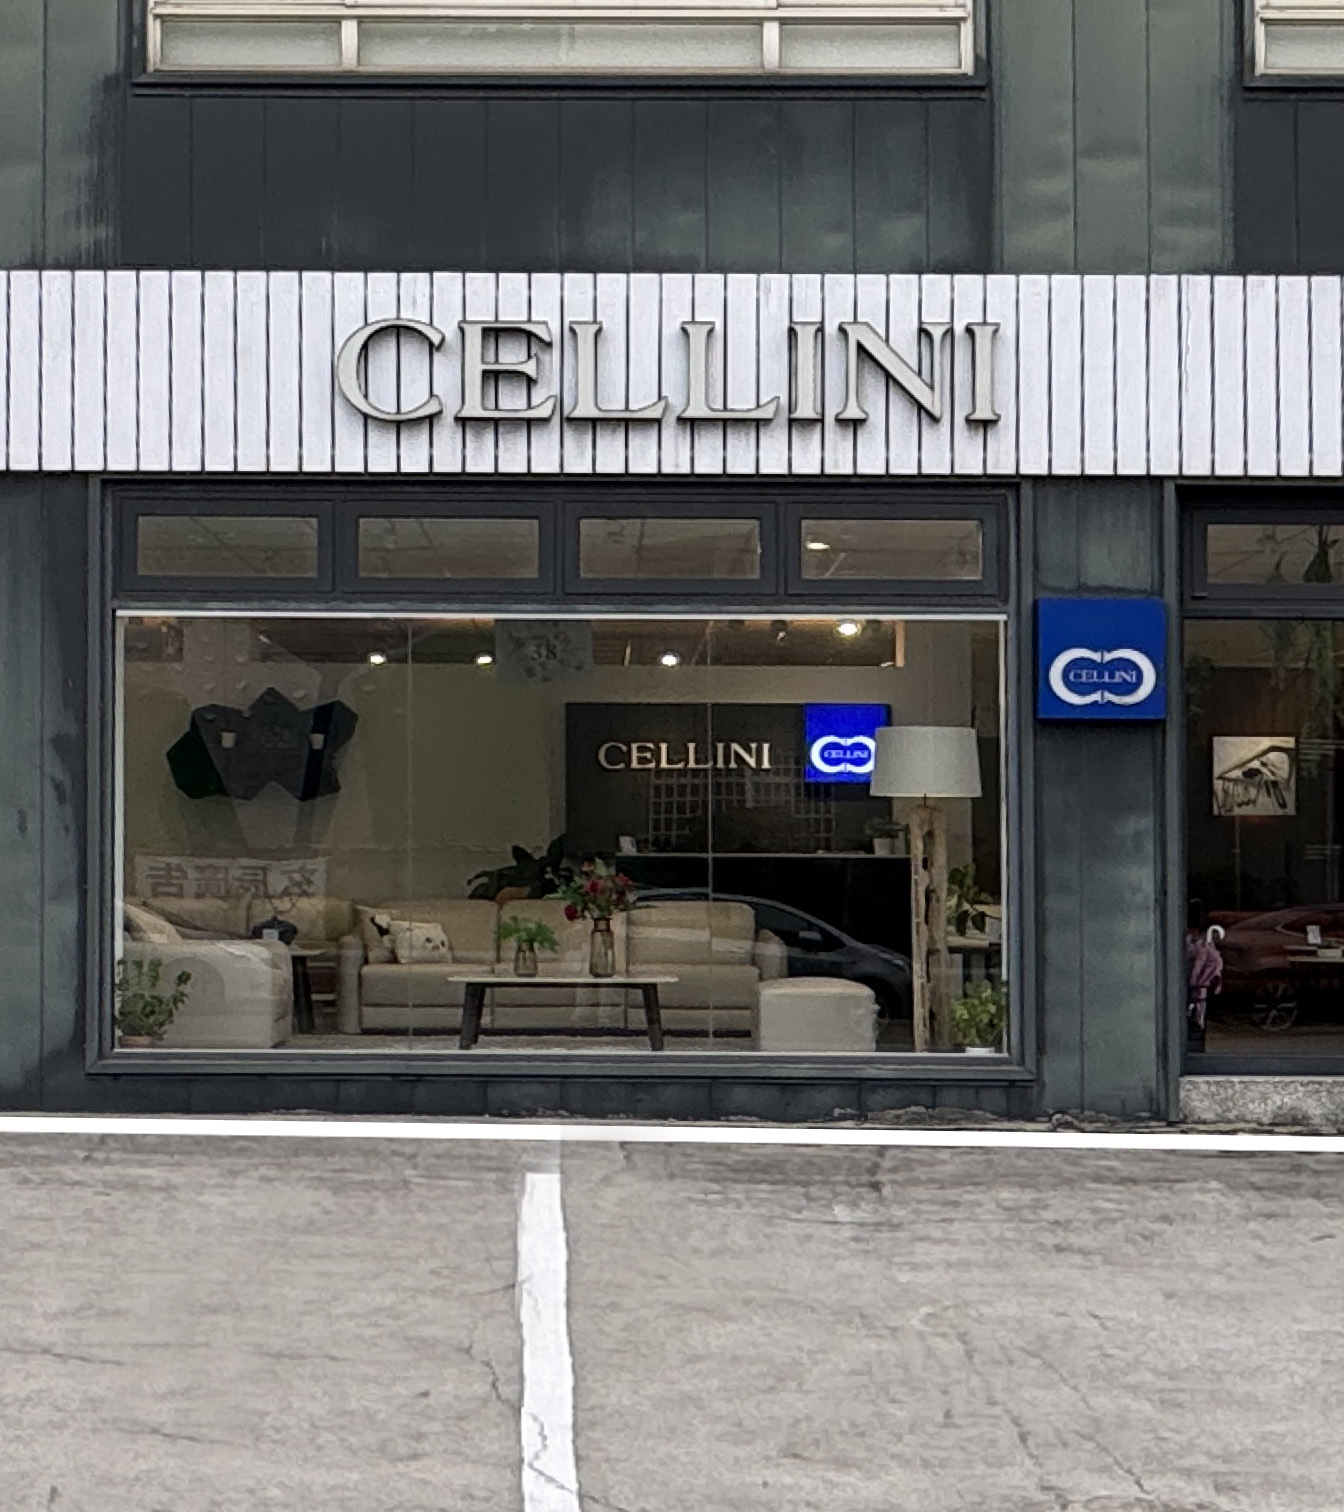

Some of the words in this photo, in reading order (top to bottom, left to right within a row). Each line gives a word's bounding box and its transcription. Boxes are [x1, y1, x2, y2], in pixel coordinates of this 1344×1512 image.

[333, 317, 1002, 424] CELLINI
[1068, 668, 1137, 684] CELLINI
[597, 740, 772, 771] CELLINI
